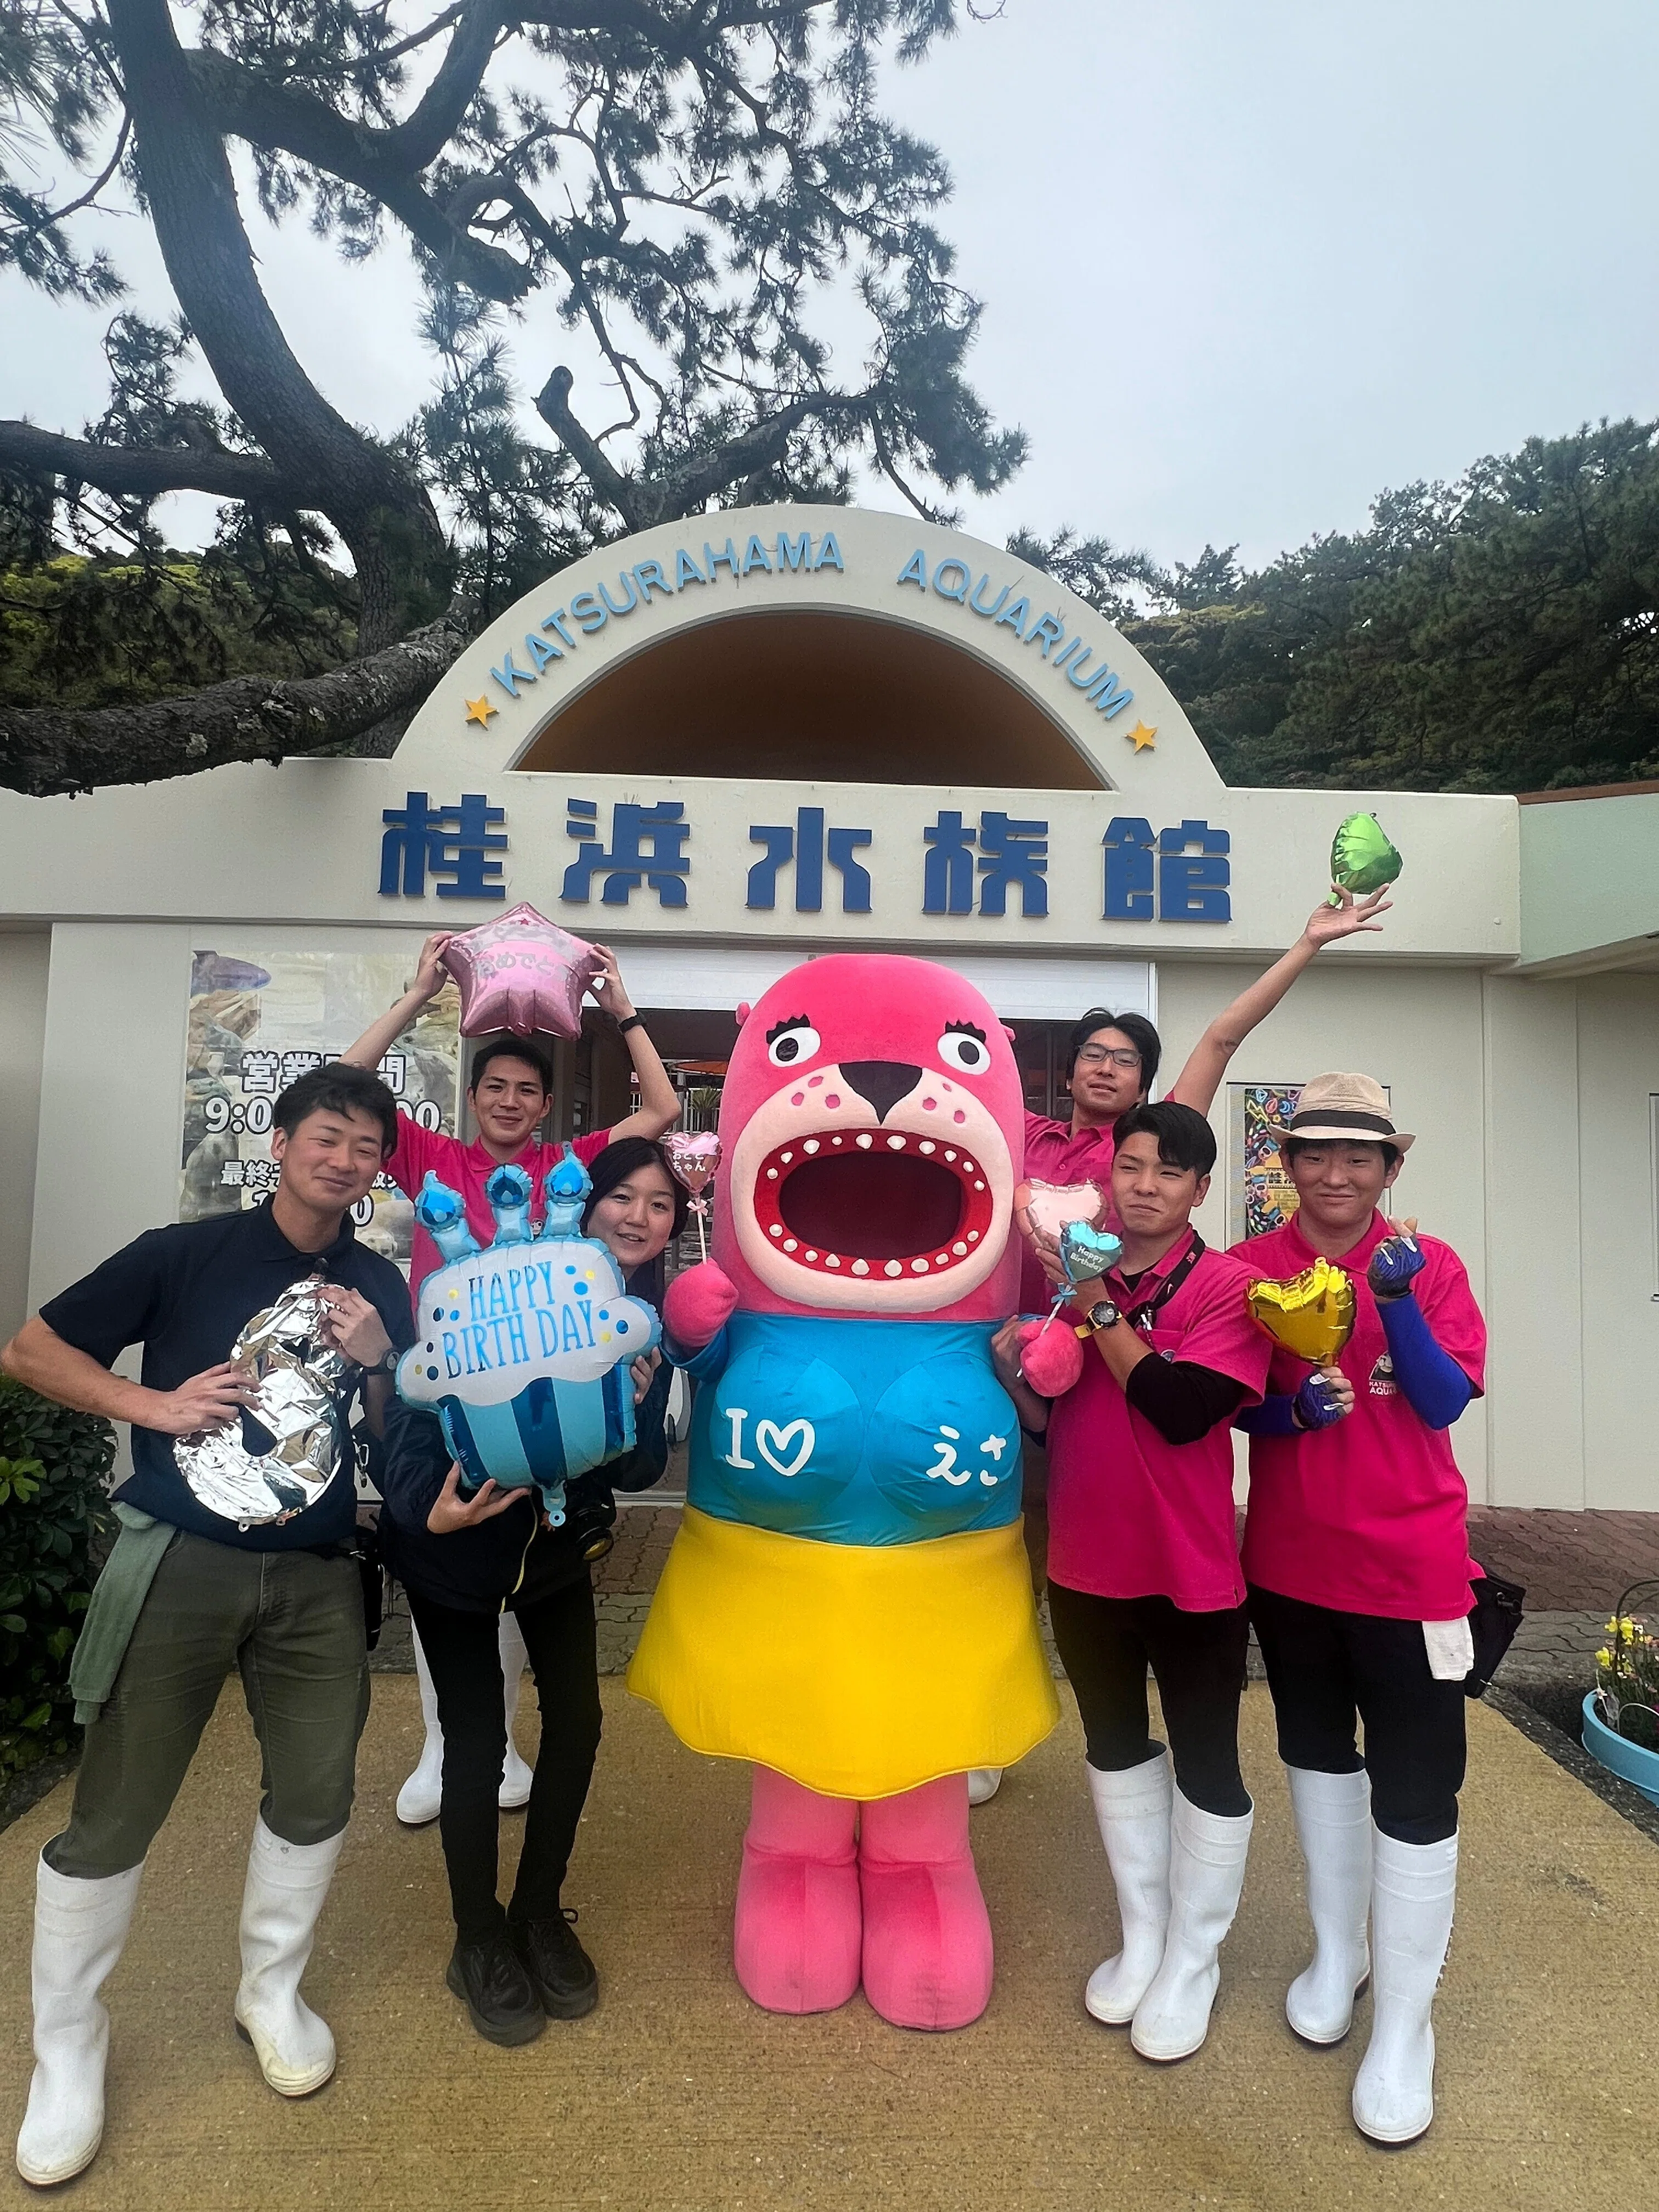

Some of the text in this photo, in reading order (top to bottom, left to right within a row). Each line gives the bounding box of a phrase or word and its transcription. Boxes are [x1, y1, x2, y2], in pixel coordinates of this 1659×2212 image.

[489, 531, 1136, 721] KATSURAHAMA AQUARIUM
[378, 791, 1232, 924] 桂浜水族館
[241, 1051, 406, 1095] 営業間
[673, 1160, 707, 1172] ちゃん
[1070, 1252, 1104, 1272] Birthday
[1077, 1245, 1104, 1263] Happy
[468, 1261, 556, 1322] HAPPY
[442, 1299, 596, 1379] BIRTH DAY
[725, 1408, 755, 1470] I
[926, 1425, 1007, 1486] えさ
